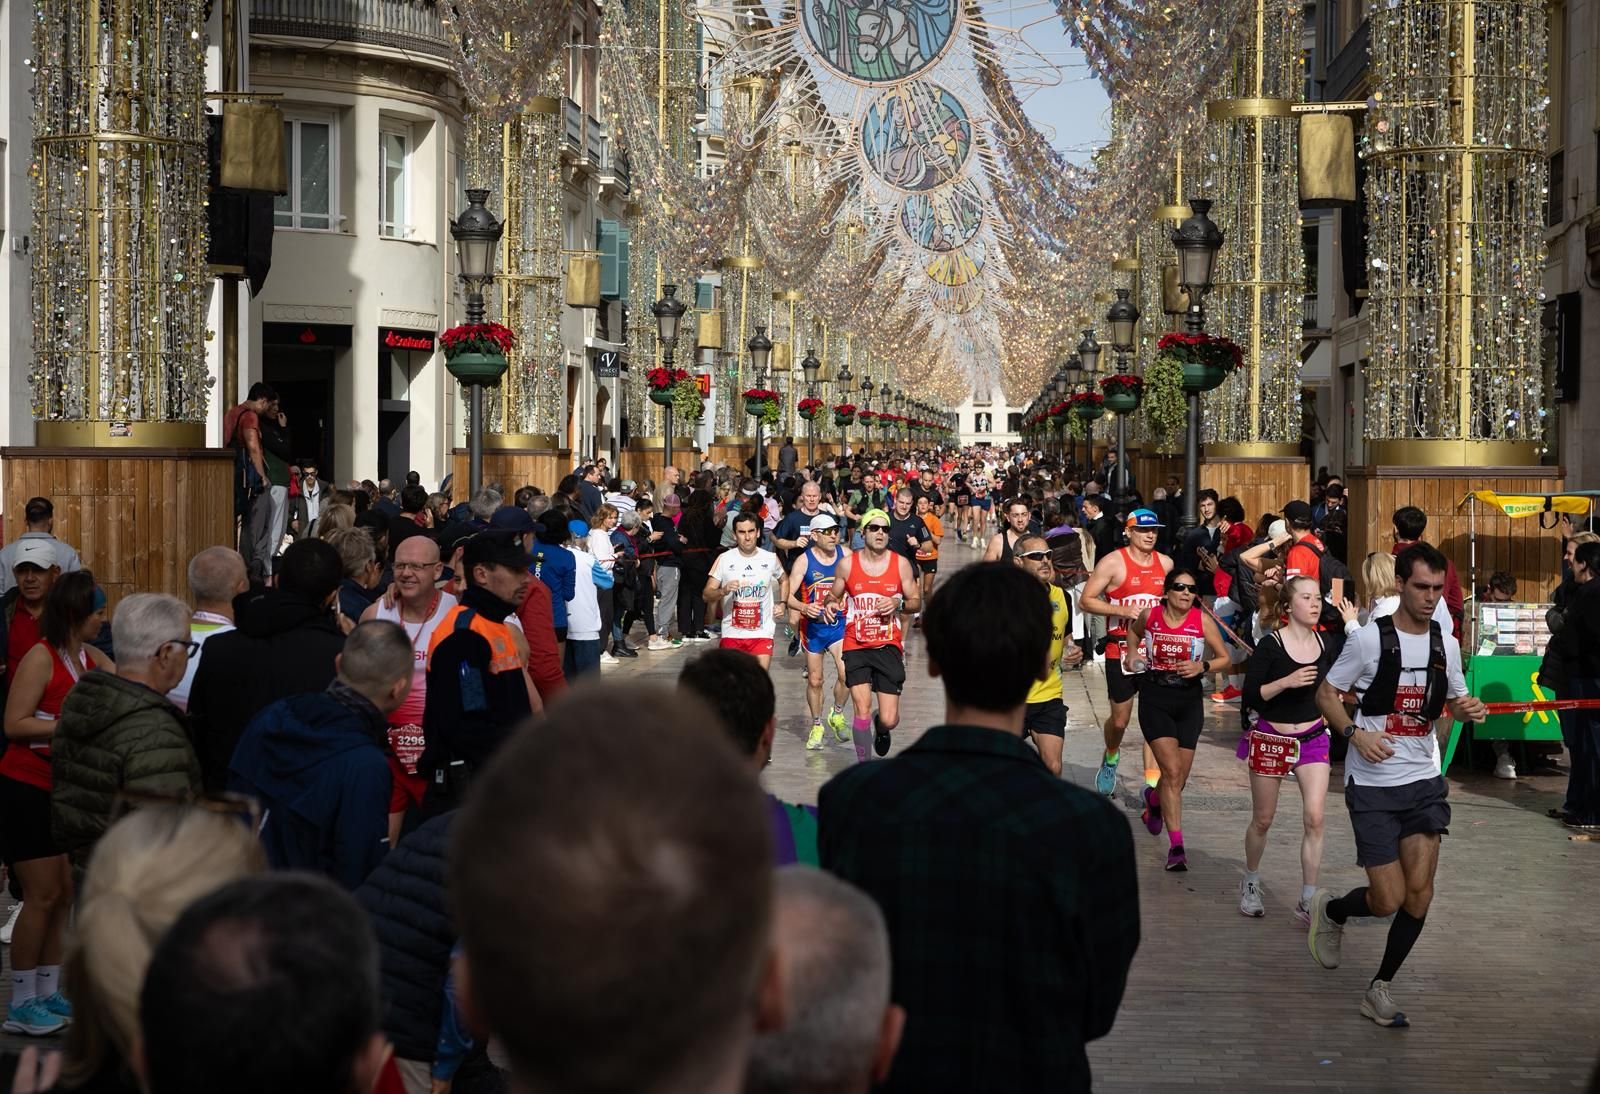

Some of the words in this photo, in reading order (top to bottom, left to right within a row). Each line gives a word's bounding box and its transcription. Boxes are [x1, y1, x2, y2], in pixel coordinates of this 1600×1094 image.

[1161, 643, 1183, 653] 3666
[397, 735, 426, 746] 3296
[1260, 743, 1284, 754] 8159
